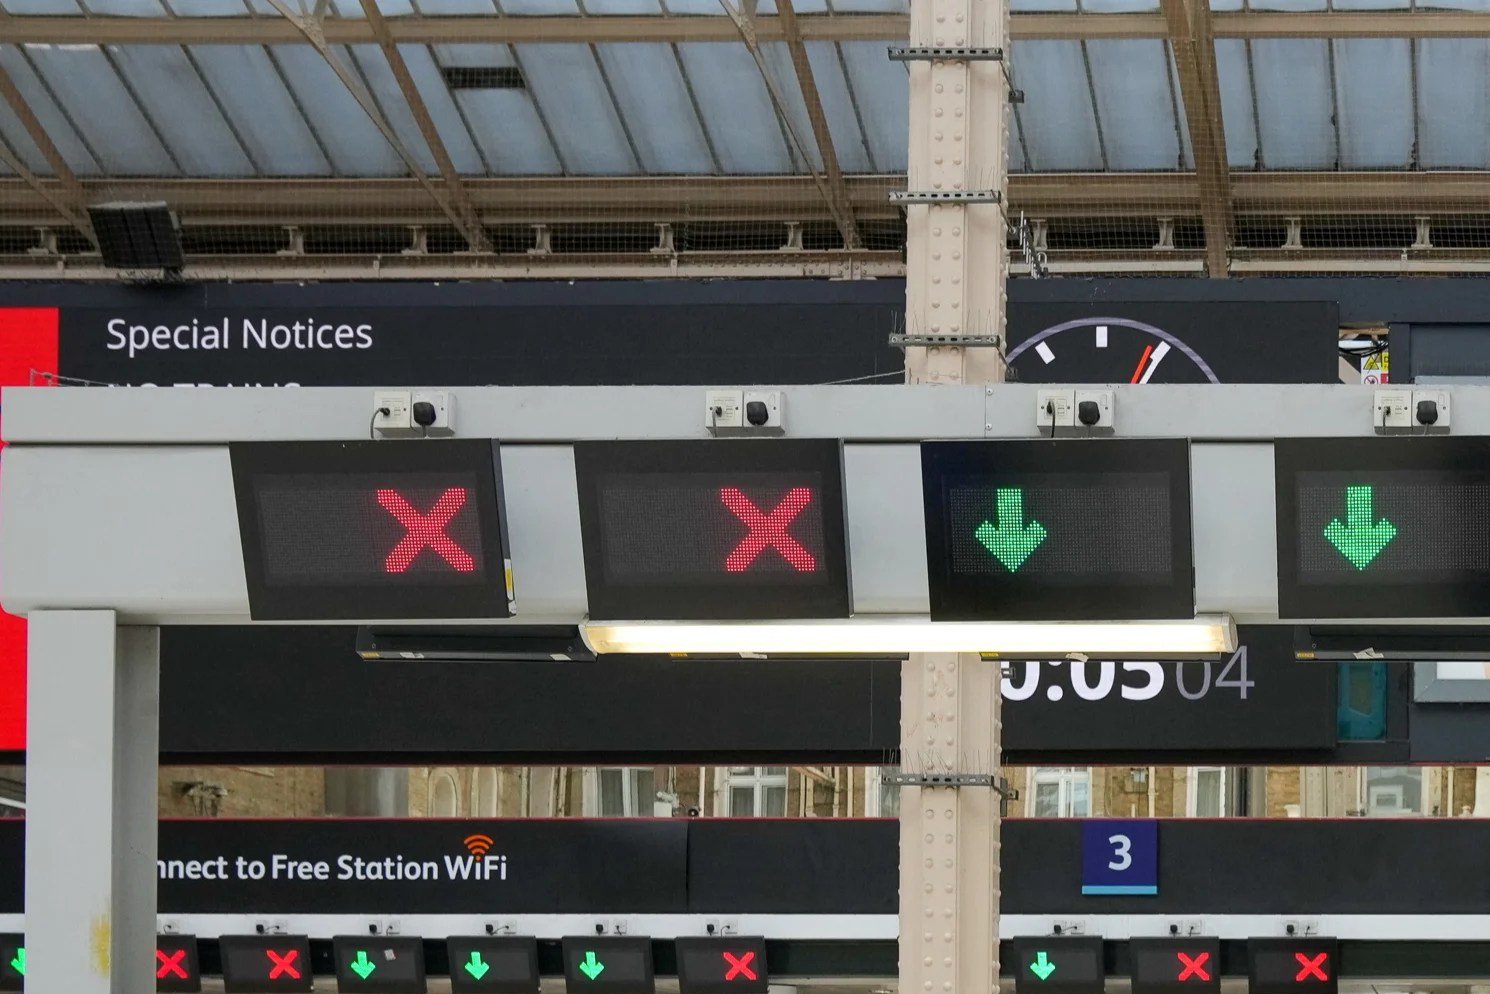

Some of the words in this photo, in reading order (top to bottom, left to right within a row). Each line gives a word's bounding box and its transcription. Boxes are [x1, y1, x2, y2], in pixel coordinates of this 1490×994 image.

[106, 317, 229, 358] Special
[243, 318, 373, 350] Notices
[1176, 646, 1255, 700] 04
[236, 856, 266, 880] to
[272, 855, 329, 880] Free
[337, 855, 438, 880] Station
[444, 855, 507, 881] WiFi
[1108, 834, 1132, 871] 3
